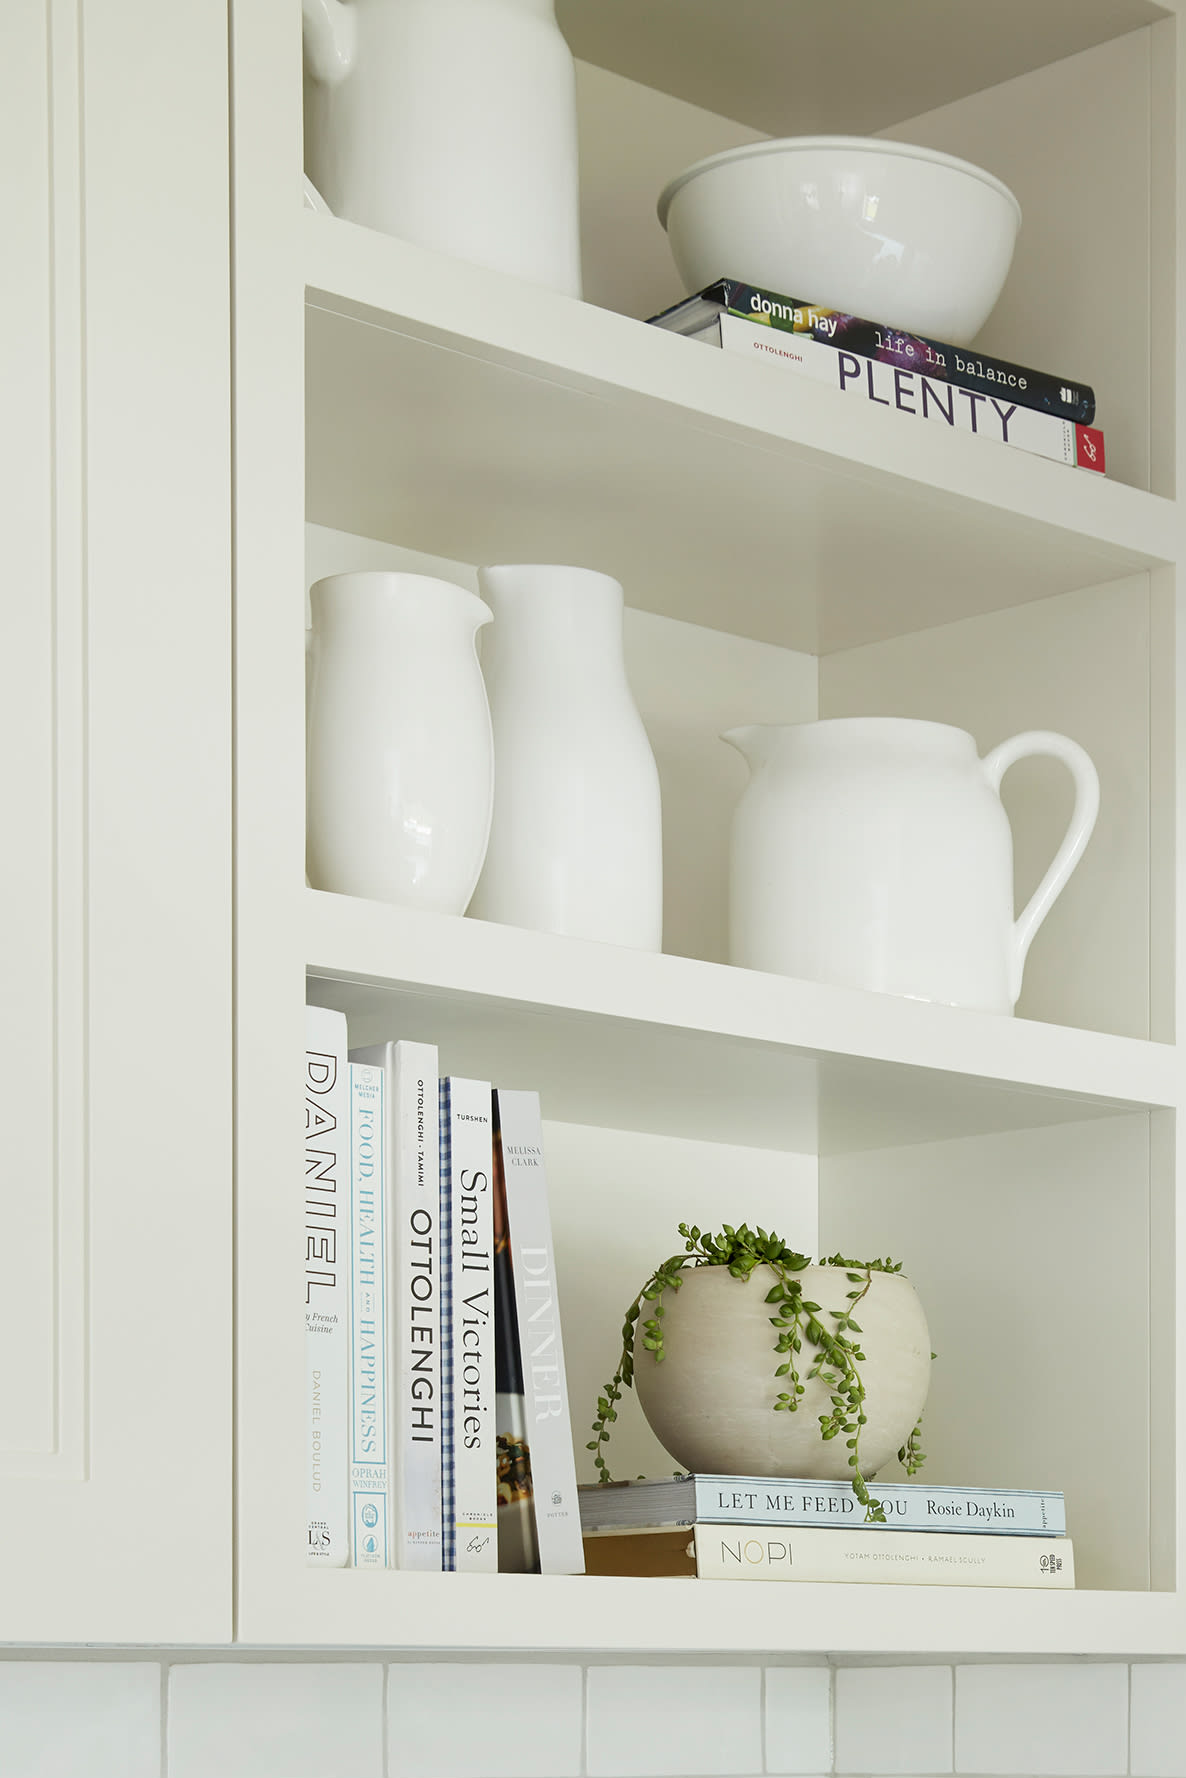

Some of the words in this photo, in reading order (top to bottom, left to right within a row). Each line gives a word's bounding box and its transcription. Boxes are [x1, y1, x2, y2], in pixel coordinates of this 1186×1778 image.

[750, 293, 803, 324] donna
[808, 308, 838, 337] hay
[753, 342, 803, 363] OTTOLENGHI
[875, 331, 915, 357] life
[925, 346, 946, 367] in
[955, 355, 1028, 390] balance
[838, 351, 1017, 443] PLENTY
[416, 1079, 425, 1142] OTTOLENGHI
[456, 1113, 488, 1123] TURSHEN
[358, 1107, 374, 1182] FOOD,
[507, 1146, 541, 1156] MELISSA
[511, 1158, 539, 1167] CLARK
[305, 1050, 337, 1304] DANIEL
[417, 1151, 425, 1187] TAMIMI
[359, 1190, 375, 1285] HEALTH
[460, 1169, 490, 1272] Small
[312, 1312, 338, 1323] French
[410, 1209, 434, 1442] OTTOLENGHI
[520, 1244, 563, 1424] DINNER
[360, 1319, 377, 1453] HAPPINESS
[462, 1288, 490, 1449] Victories
[312, 1370, 321, 1424] DANIEL
[312, 1431, 321, 1492] BOULUD
[352, 1467, 386, 1479] OPRAH
[352, 1480, 387, 1489] WINFREY
[718, 1492, 758, 1510] LET
[766, 1494, 795, 1511] ME
[802, 1496, 854, 1513] FEED
[927, 1500, 962, 1516] Rosie
[966, 1501, 1015, 1521] Daykin
[408, 1530, 440, 1539] appetite
[721, 1539, 793, 1565] NOPI
[845, 1552, 870, 1560] YOTAM
[873, 1553, 919, 1562] OTTOLENGHI
[928, 1555, 957, 1563] RAMAEL
[959, 1556, 986, 1564] SCULLY
